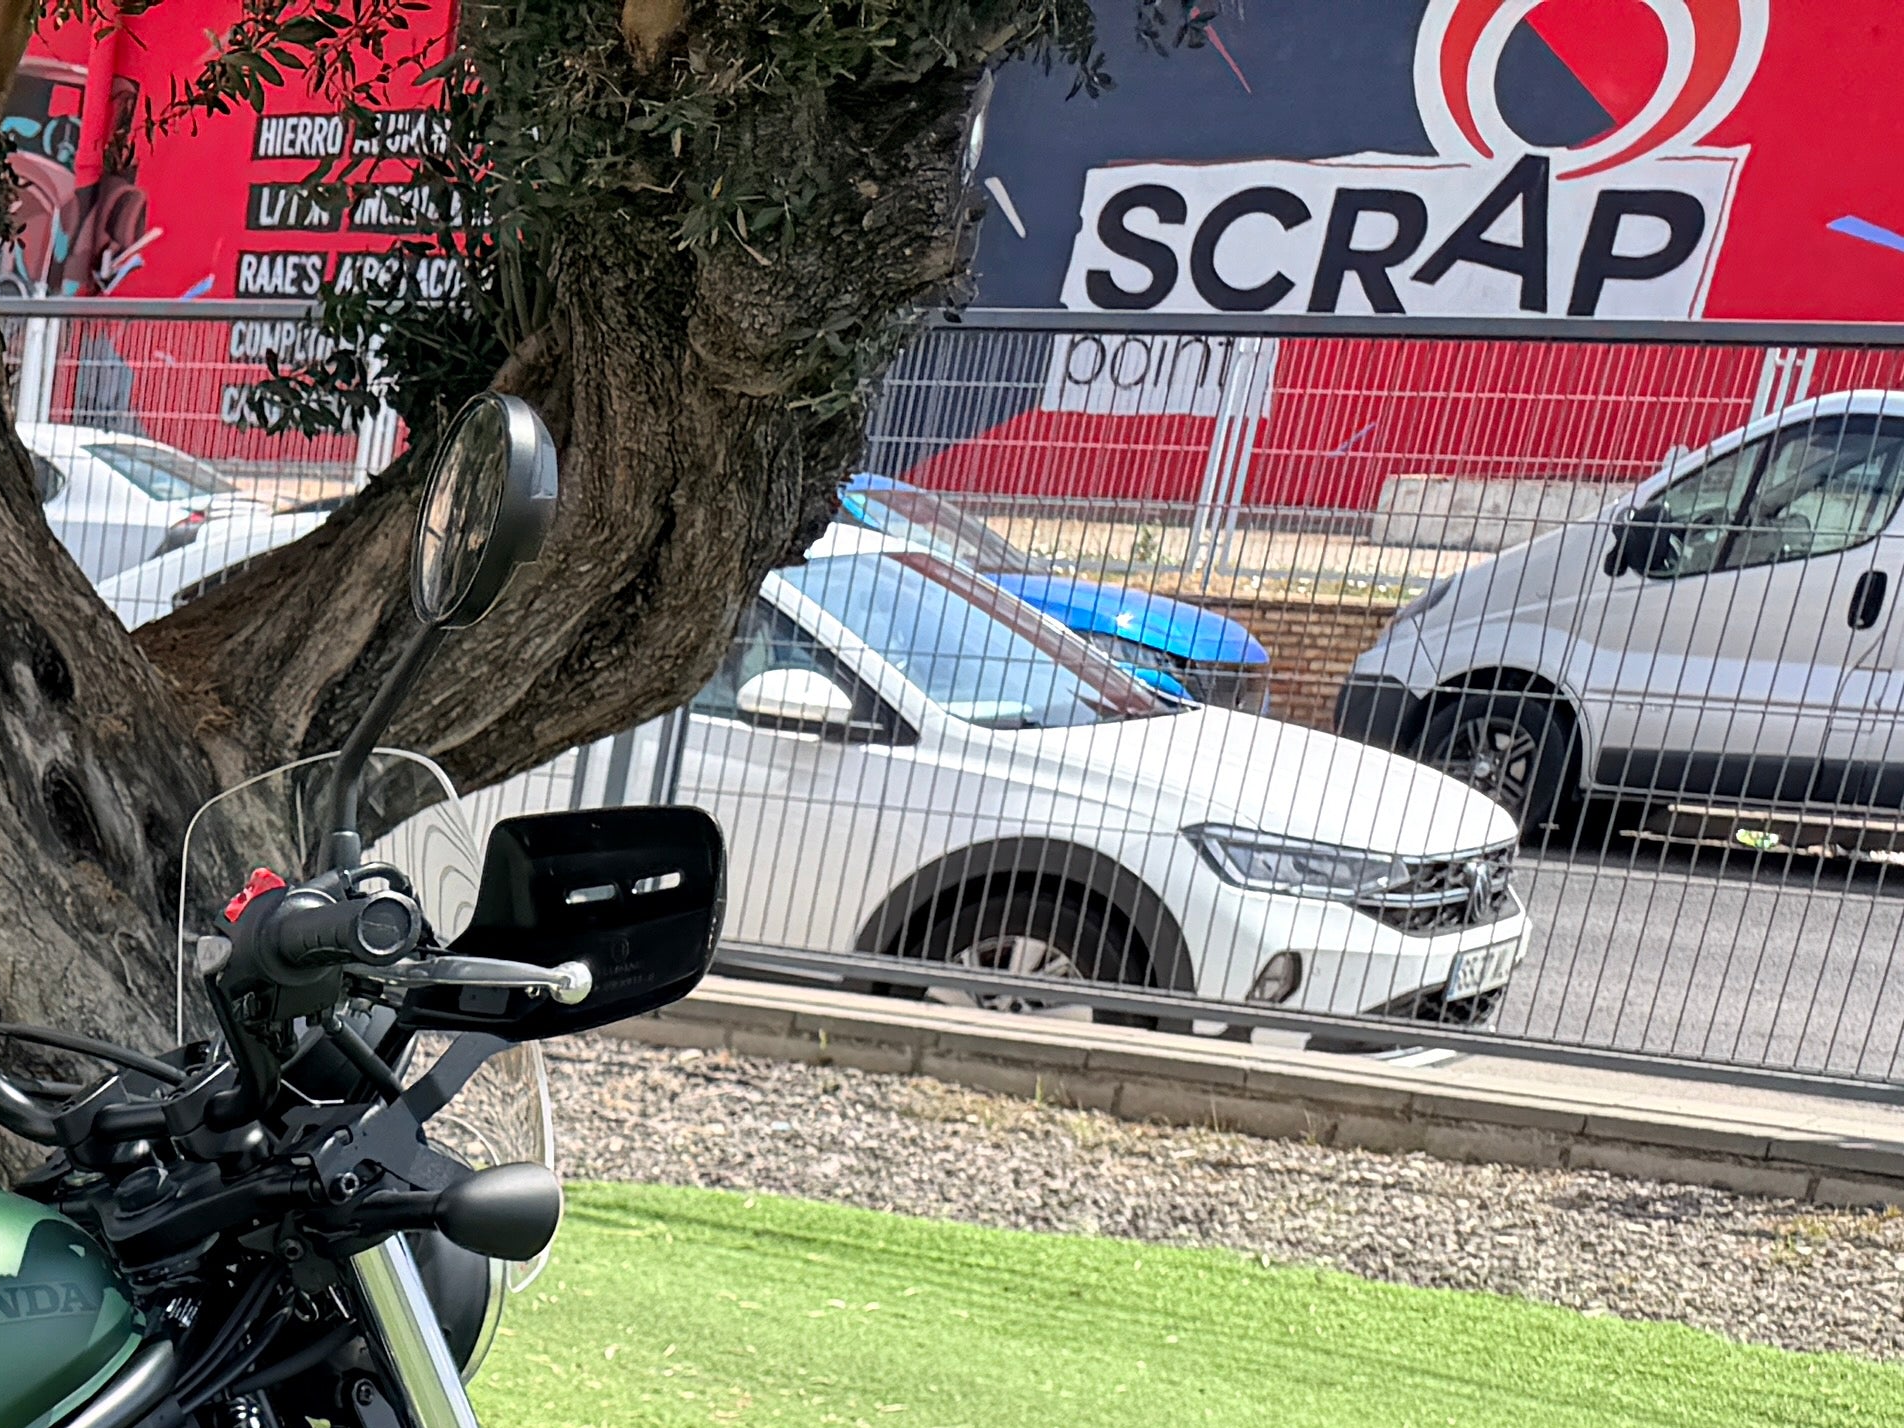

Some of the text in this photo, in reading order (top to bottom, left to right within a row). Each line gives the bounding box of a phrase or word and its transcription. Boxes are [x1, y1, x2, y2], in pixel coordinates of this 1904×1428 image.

[259, 115, 343, 157] HIERRO
[1085, 153, 1706, 317] SCRAP
[239, 253, 322, 295] RAAE'S
